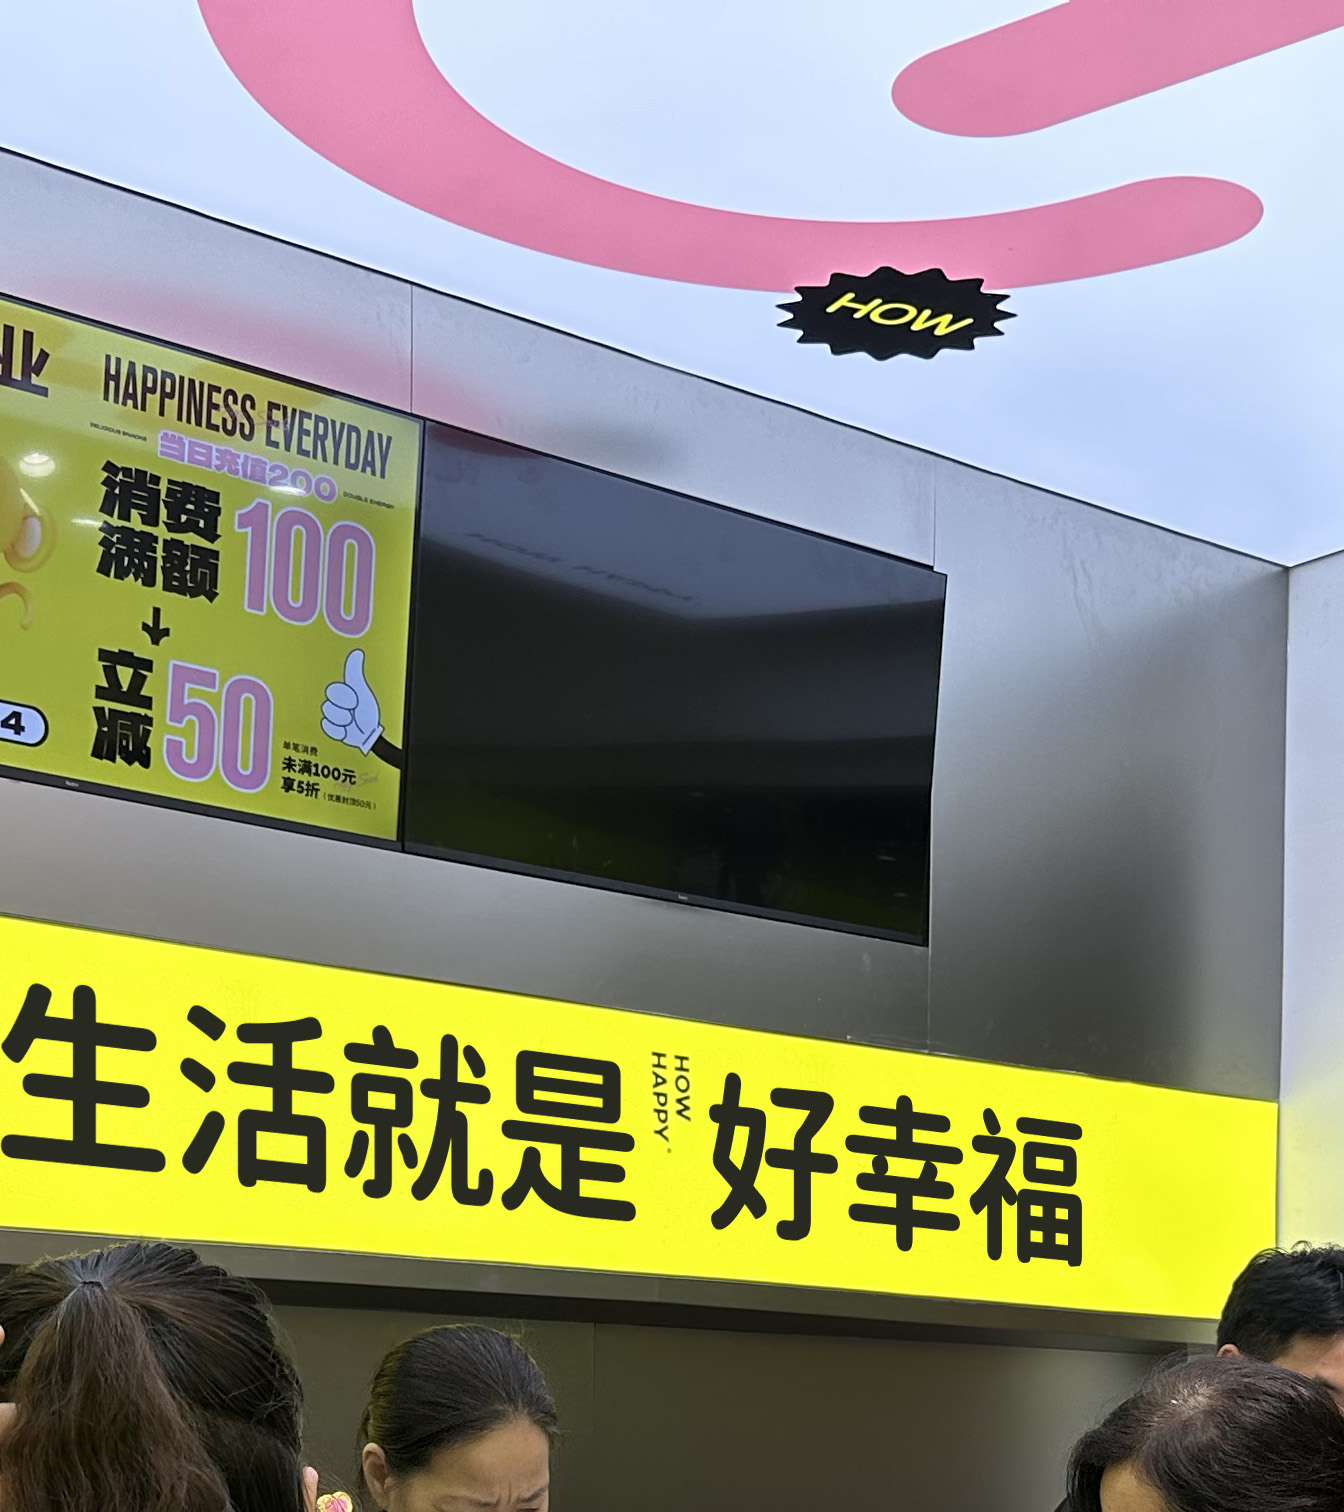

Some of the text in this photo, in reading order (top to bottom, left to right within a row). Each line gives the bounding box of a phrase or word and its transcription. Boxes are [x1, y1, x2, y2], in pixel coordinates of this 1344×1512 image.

[825, 292, 974, 336] HOW
[103, 353, 393, 479] HAPPINESS EVERYDAY
[98, 460, 222, 544] 消费
[158, 430, 338, 503] 当日充值200
[96, 520, 221, 603] 满额
[234, 498, 376, 638] 100
[162, 658, 274, 794] 50
[281, 776, 321, 799] 享5折
[282, 755, 357, 785] 未满100元
[651, 1051, 670, 1143] HAPPY
[673, 1054, 692, 1123] HOW
[708, 1072, 1083, 1267] 好幸福
